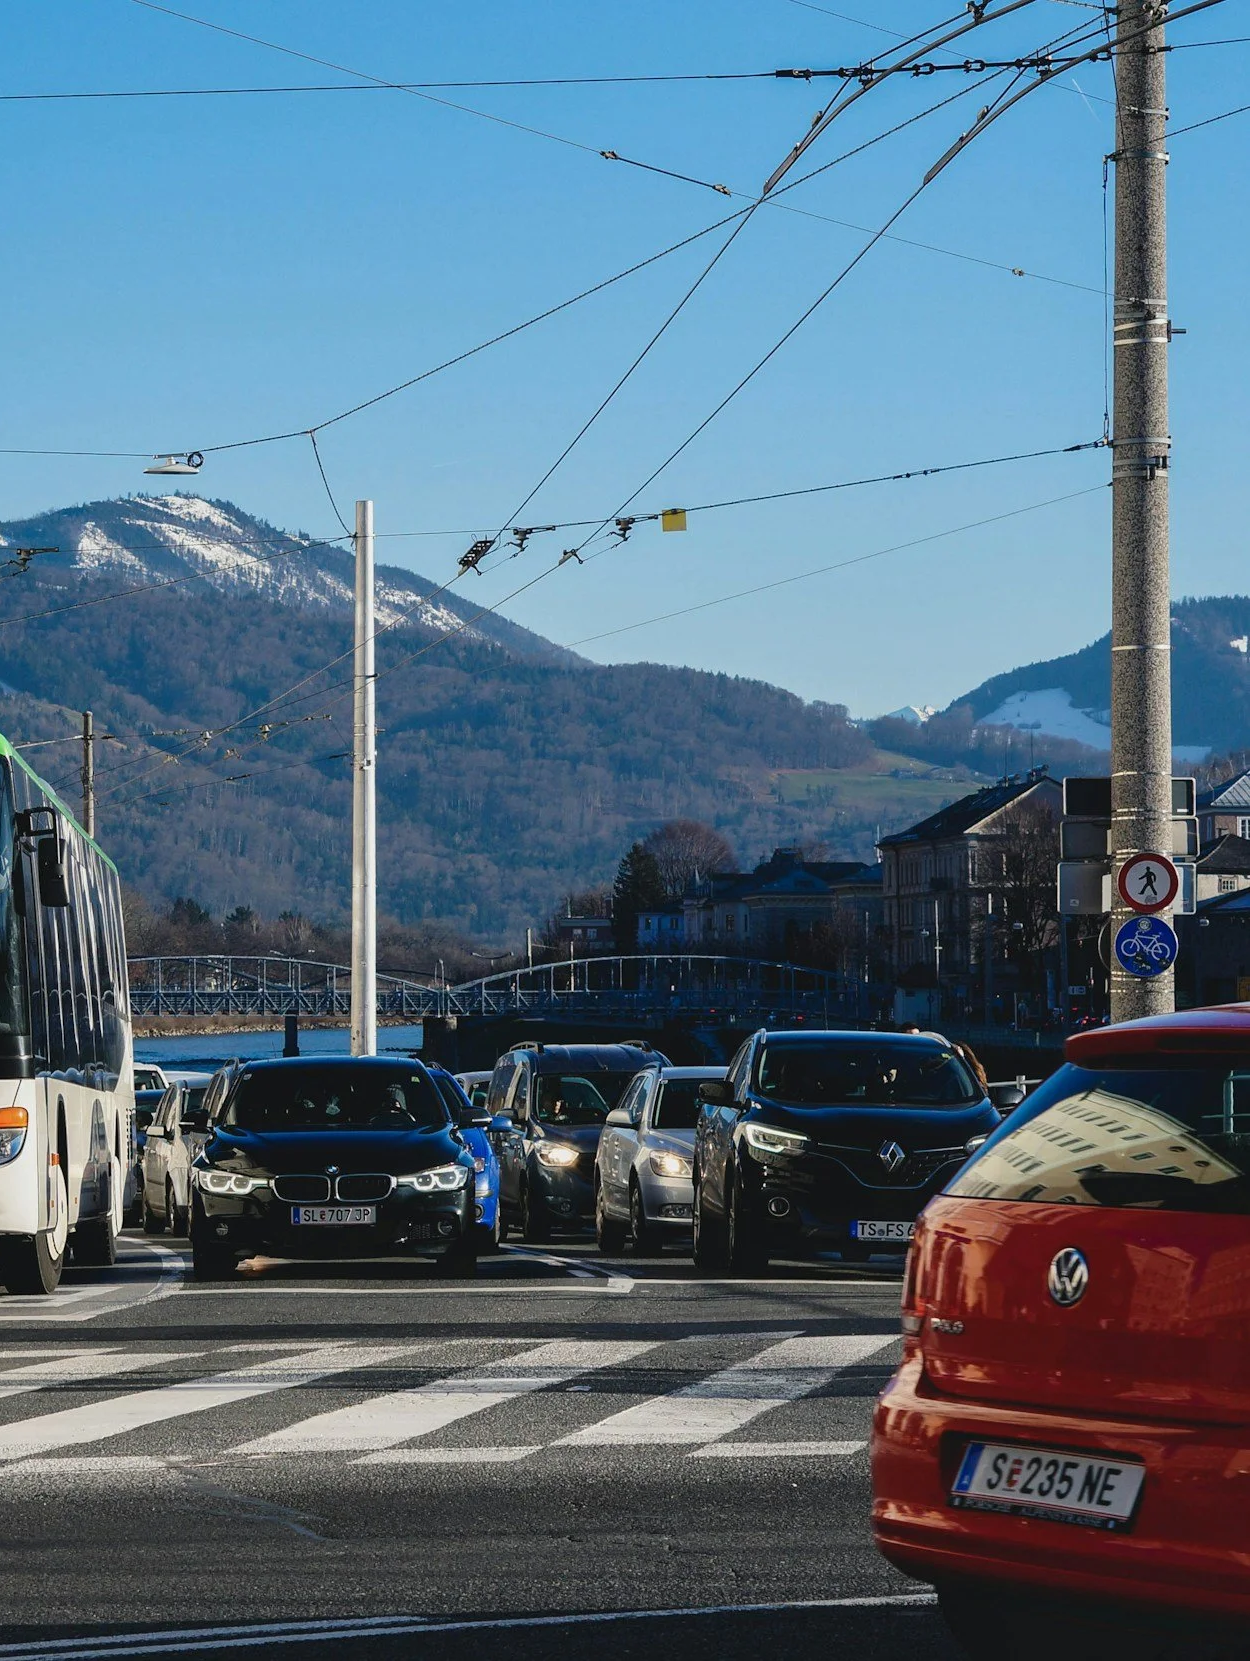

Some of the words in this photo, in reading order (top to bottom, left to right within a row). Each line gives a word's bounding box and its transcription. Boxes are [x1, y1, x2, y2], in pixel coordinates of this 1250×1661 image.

[303, 1209, 318, 1222] SL
[328, 1208, 353, 1222] 707
[354, 1208, 372, 1221] JP
[858, 1222, 877, 1236] TS
[886, 1223, 904, 1237] FS
[986, 1452, 1008, 1491] S
[1019, 1456, 1080, 1500] 235
[1077, 1464, 1123, 1507] NE
